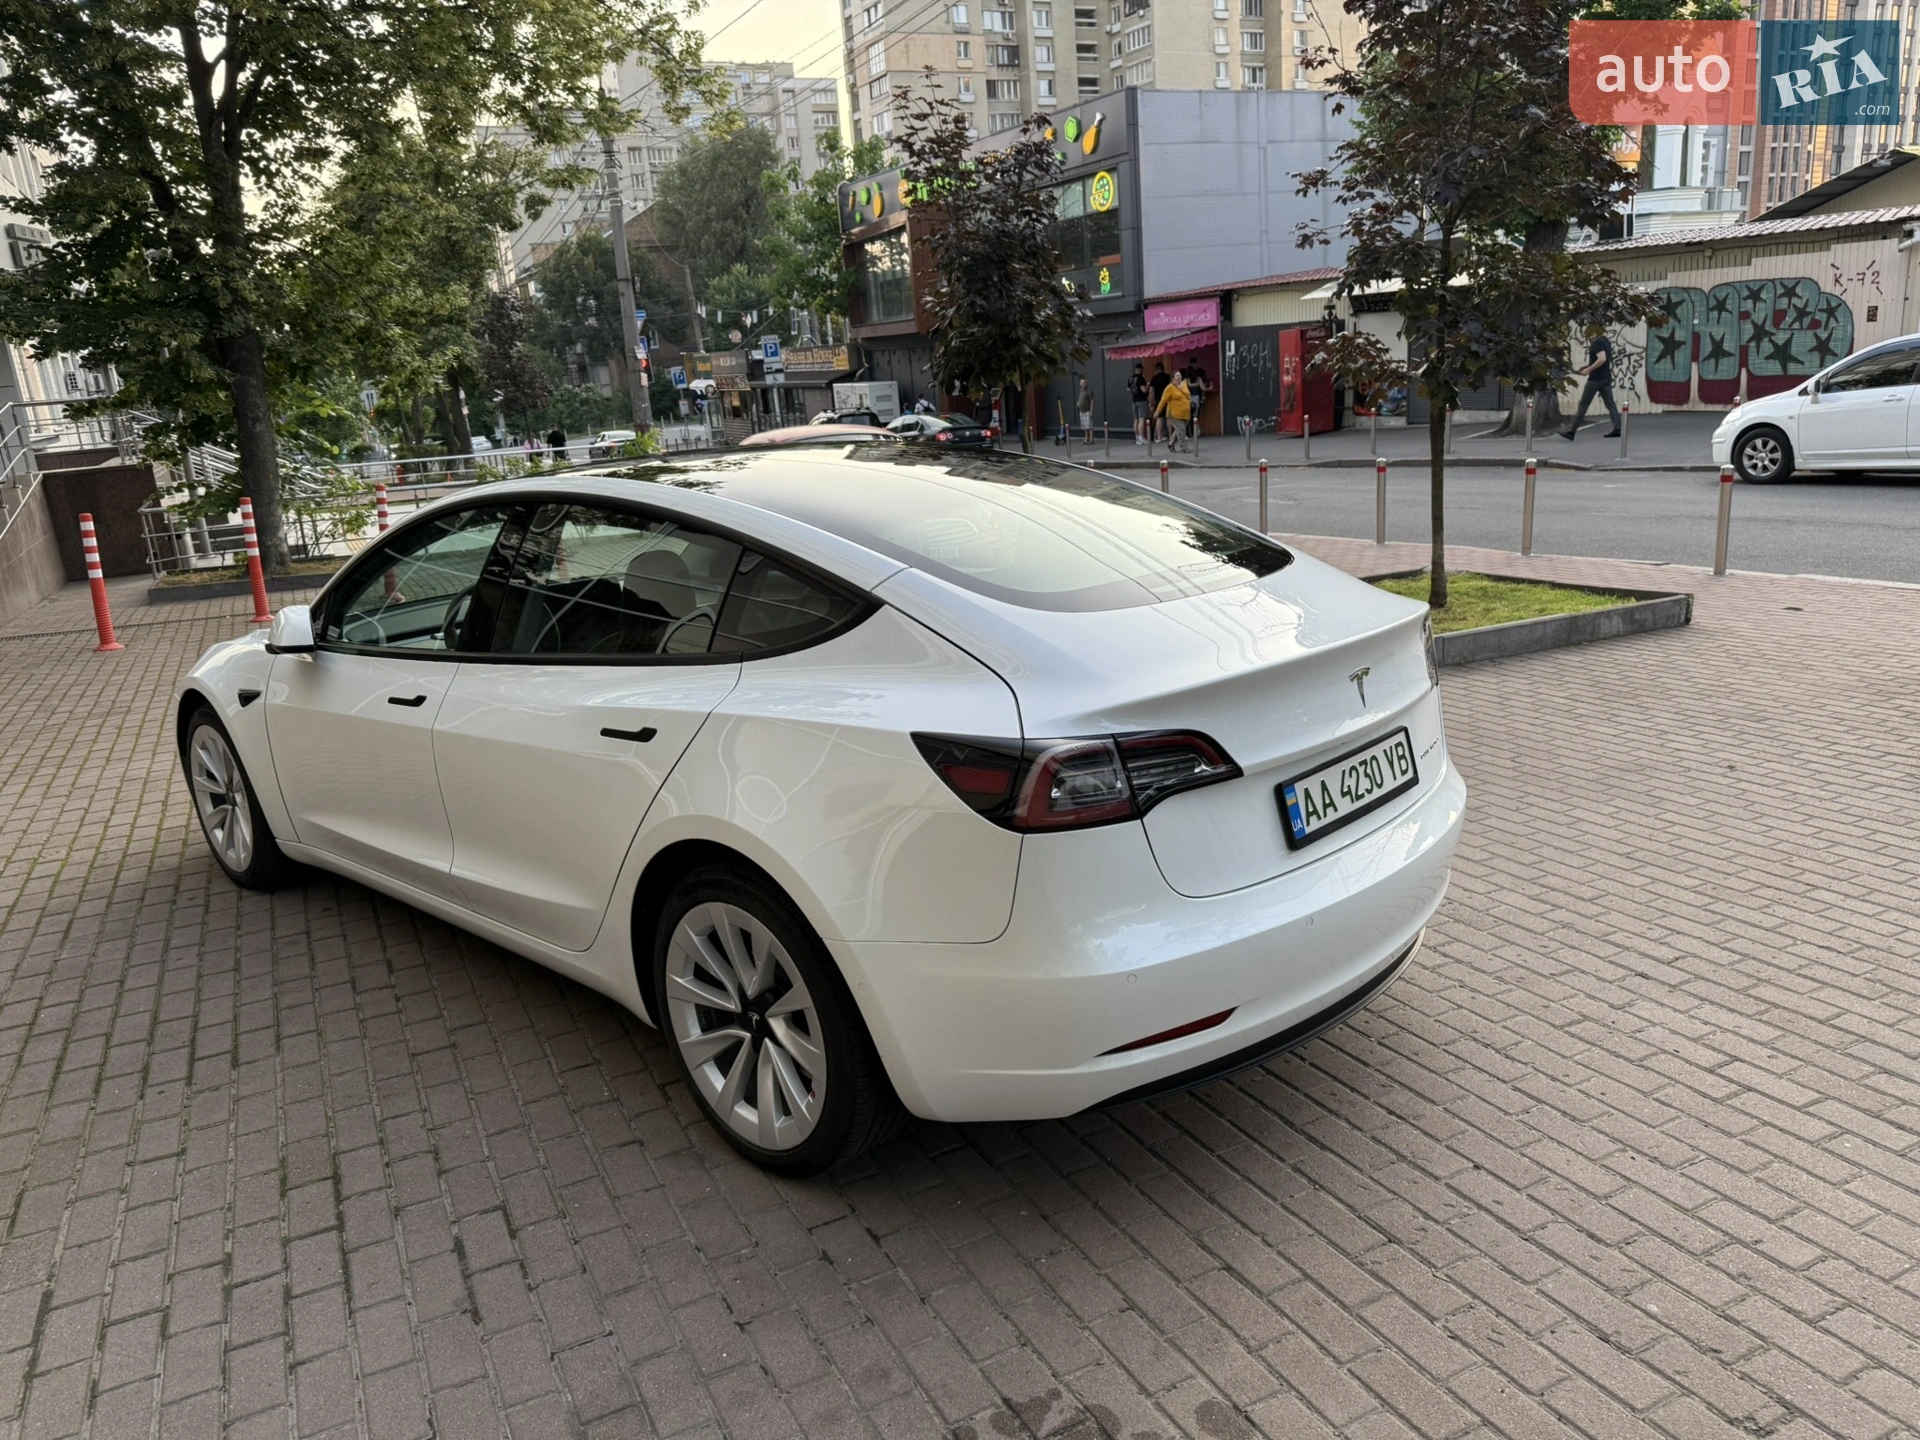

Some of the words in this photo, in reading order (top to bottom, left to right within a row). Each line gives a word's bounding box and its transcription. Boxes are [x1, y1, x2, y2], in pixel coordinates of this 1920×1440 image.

[1303, 779, 1339, 827] AA
[1340, 753, 1384, 805] 4230
[1383, 740, 1410, 781] YB
[1292, 819, 1304, 832] UA
